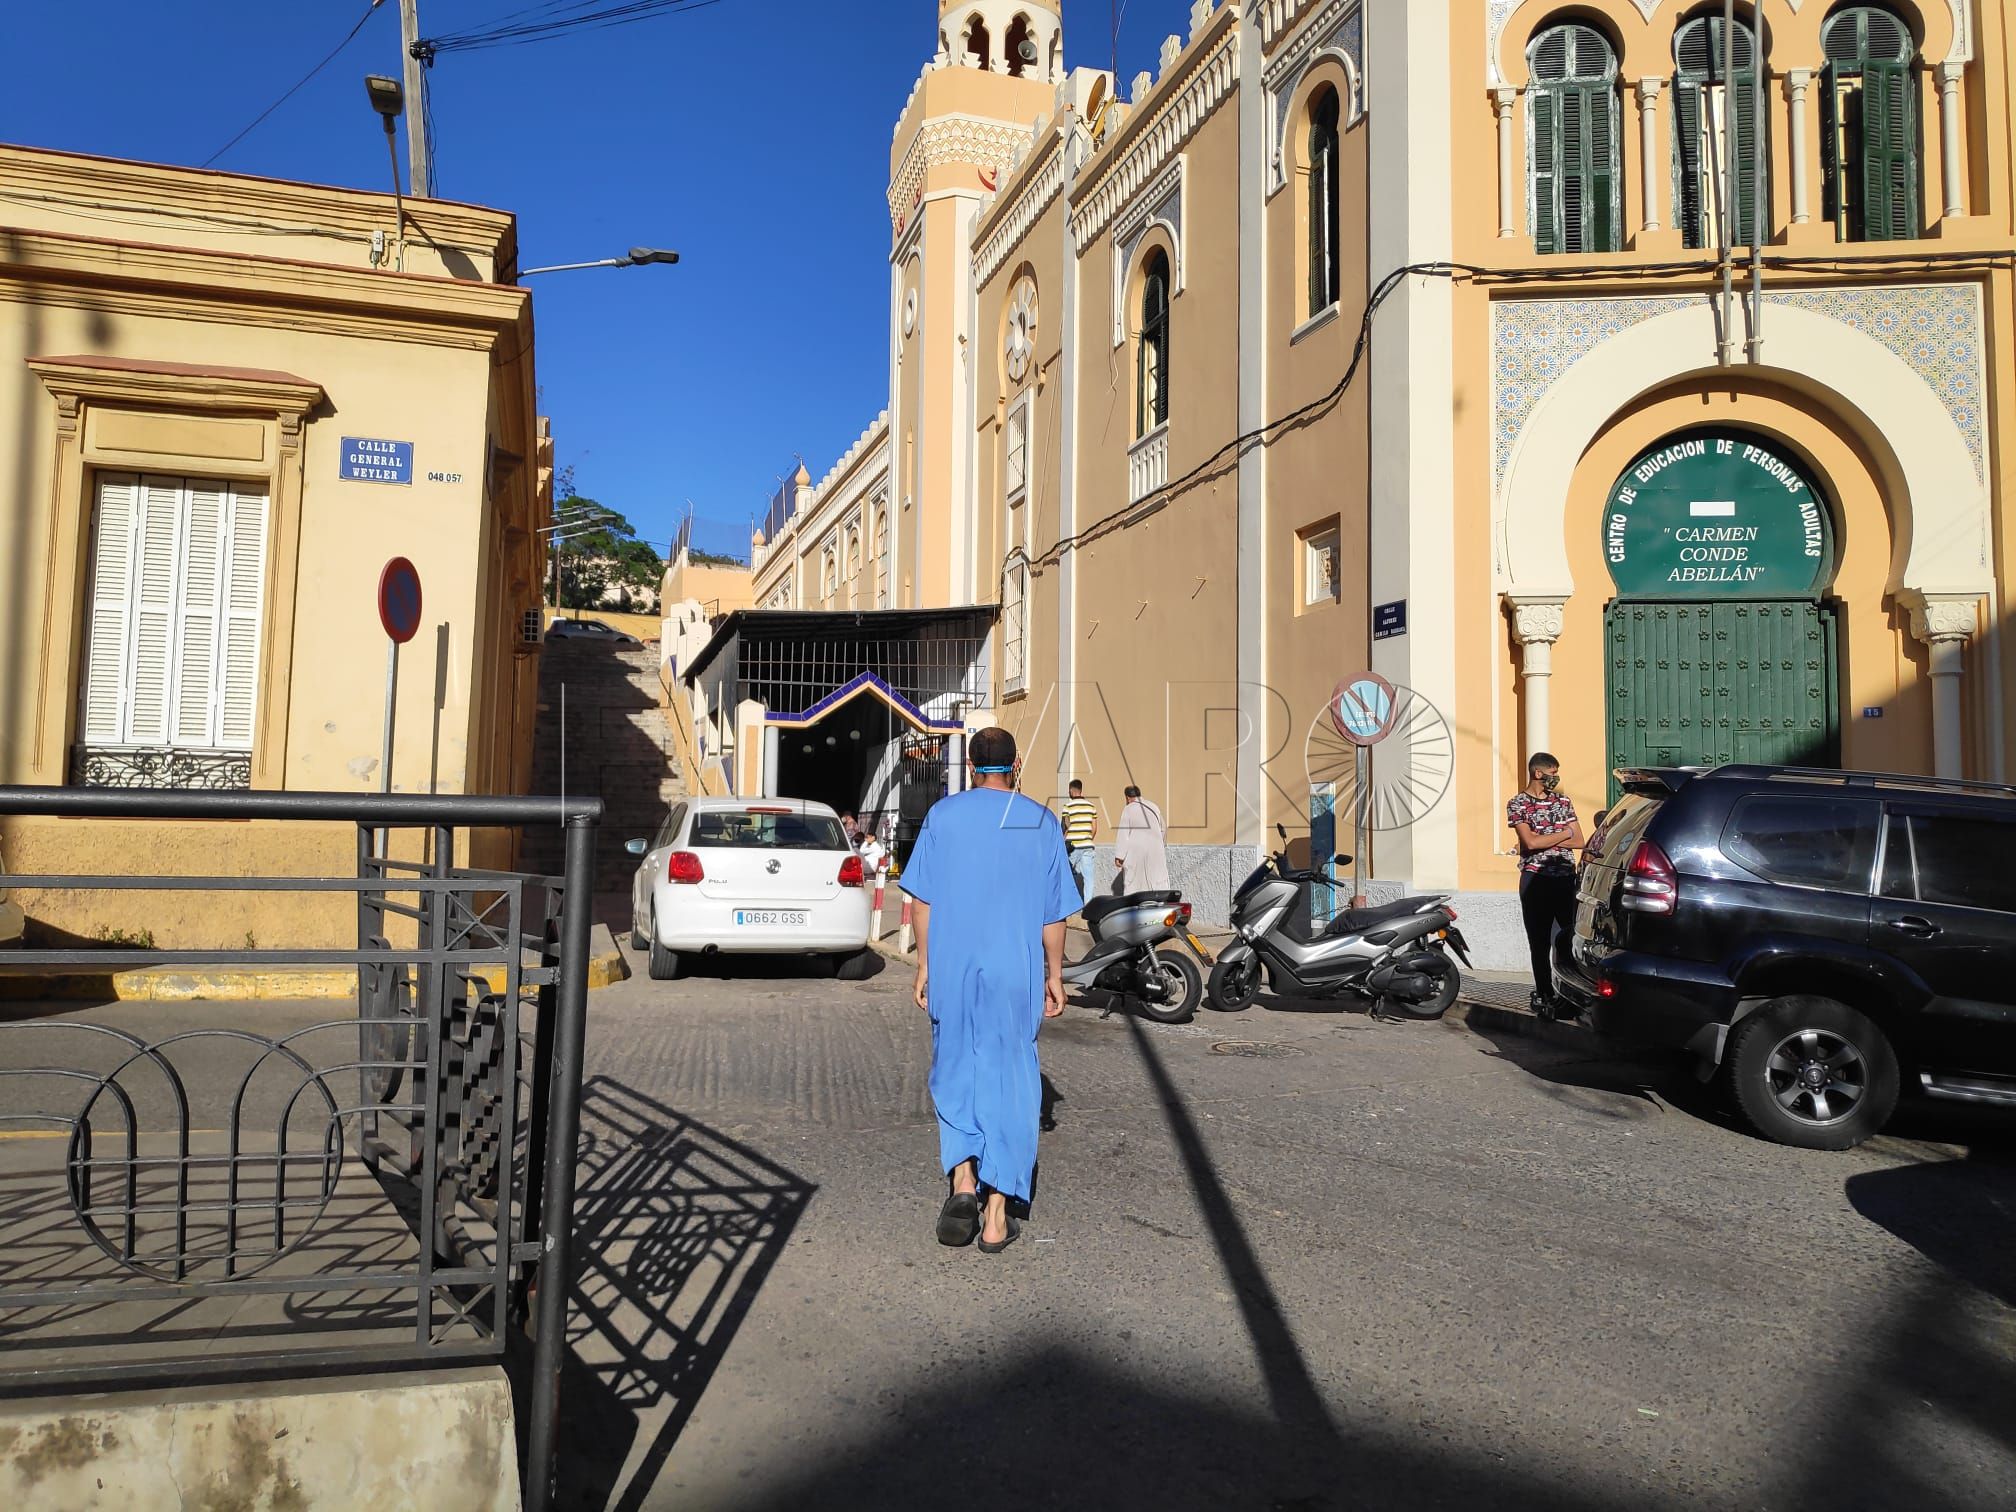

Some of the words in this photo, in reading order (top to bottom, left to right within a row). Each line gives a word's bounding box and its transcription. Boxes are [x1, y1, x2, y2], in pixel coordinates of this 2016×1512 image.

[358, 441, 396, 453] CALLE
[350, 454, 402, 467] GENERAL
[352, 467, 398, 480] WEYLER
[428, 472, 444, 482] 048
[446, 473, 462, 483] 057
[1608, 513, 1628, 563] CENTRO
[1618, 485, 1638, 506] DE
[1716, 439, 1734, 456] DE
[1742, 445, 1804, 494] PERSONAS
[1798, 501, 1823, 558] ADULTAS
[1679, 547, 1749, 562] CONDE
[746, 912, 777, 924] 0662
[781, 913, 804, 924] GSS
